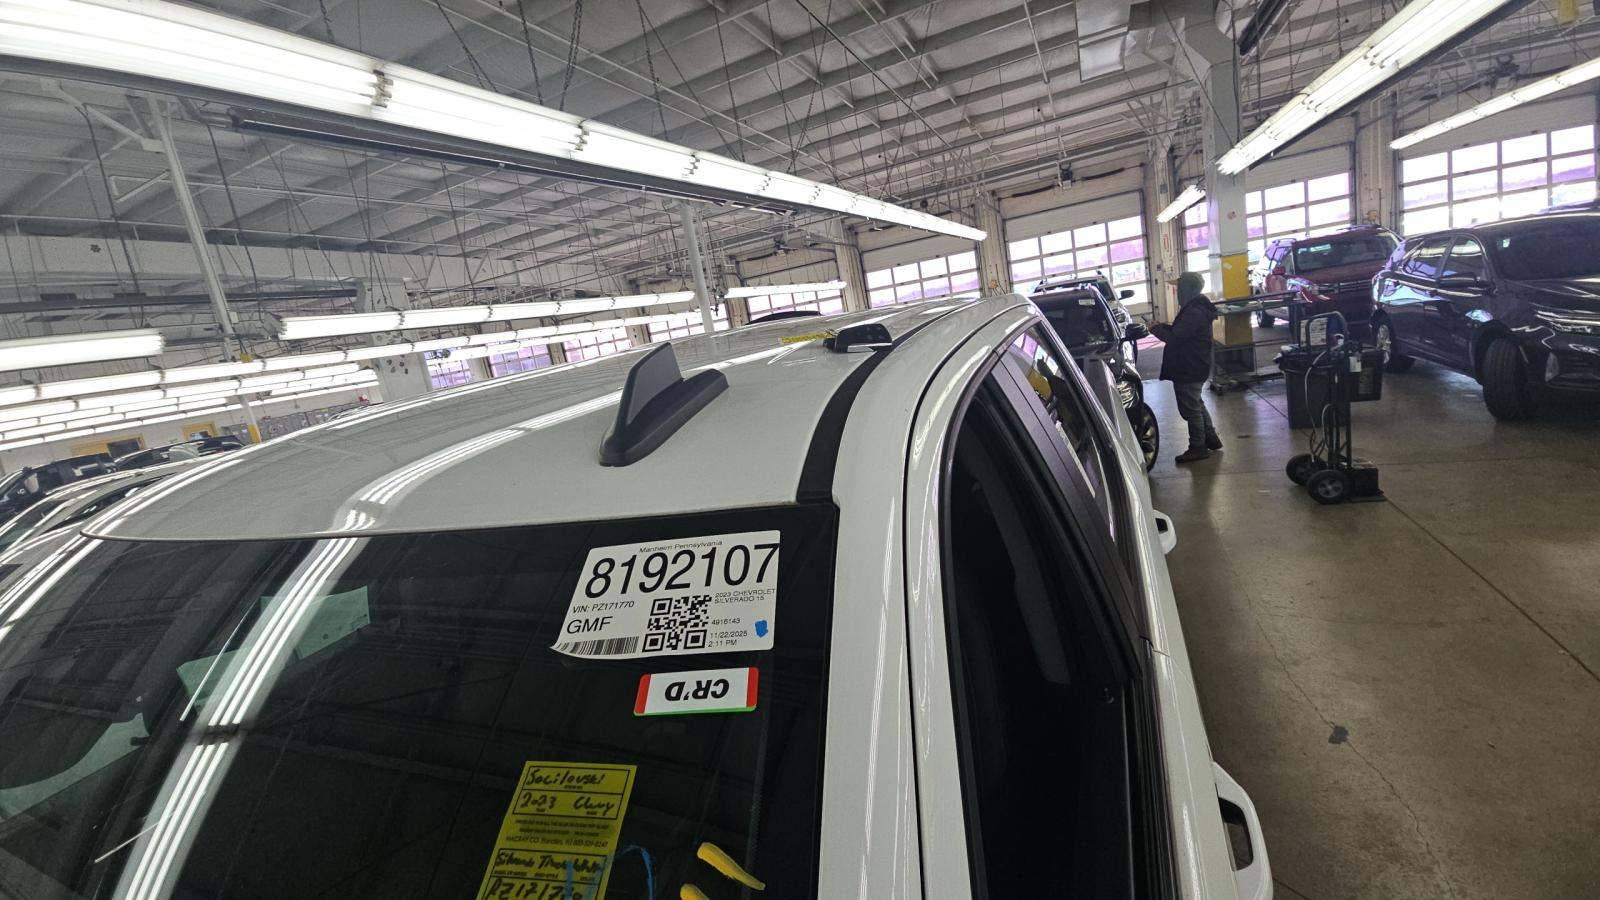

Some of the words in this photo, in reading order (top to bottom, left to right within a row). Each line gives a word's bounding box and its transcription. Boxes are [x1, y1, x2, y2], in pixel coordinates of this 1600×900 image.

[674, 540, 723, 549] Pennsylvania
[585, 543, 780, 599] 8192107
[733, 589, 775, 597] CHEVROLET
[714, 596, 755, 604] SILVERADO
[572, 605, 590, 614] VIN:
[591, 600, 635, 612] PZ171770
[566, 616, 613, 635] GMF
[710, 630, 748, 639] 11/22/2025
[708, 640, 723, 648] 2:11
[664, 678, 730, 701] CR'D
